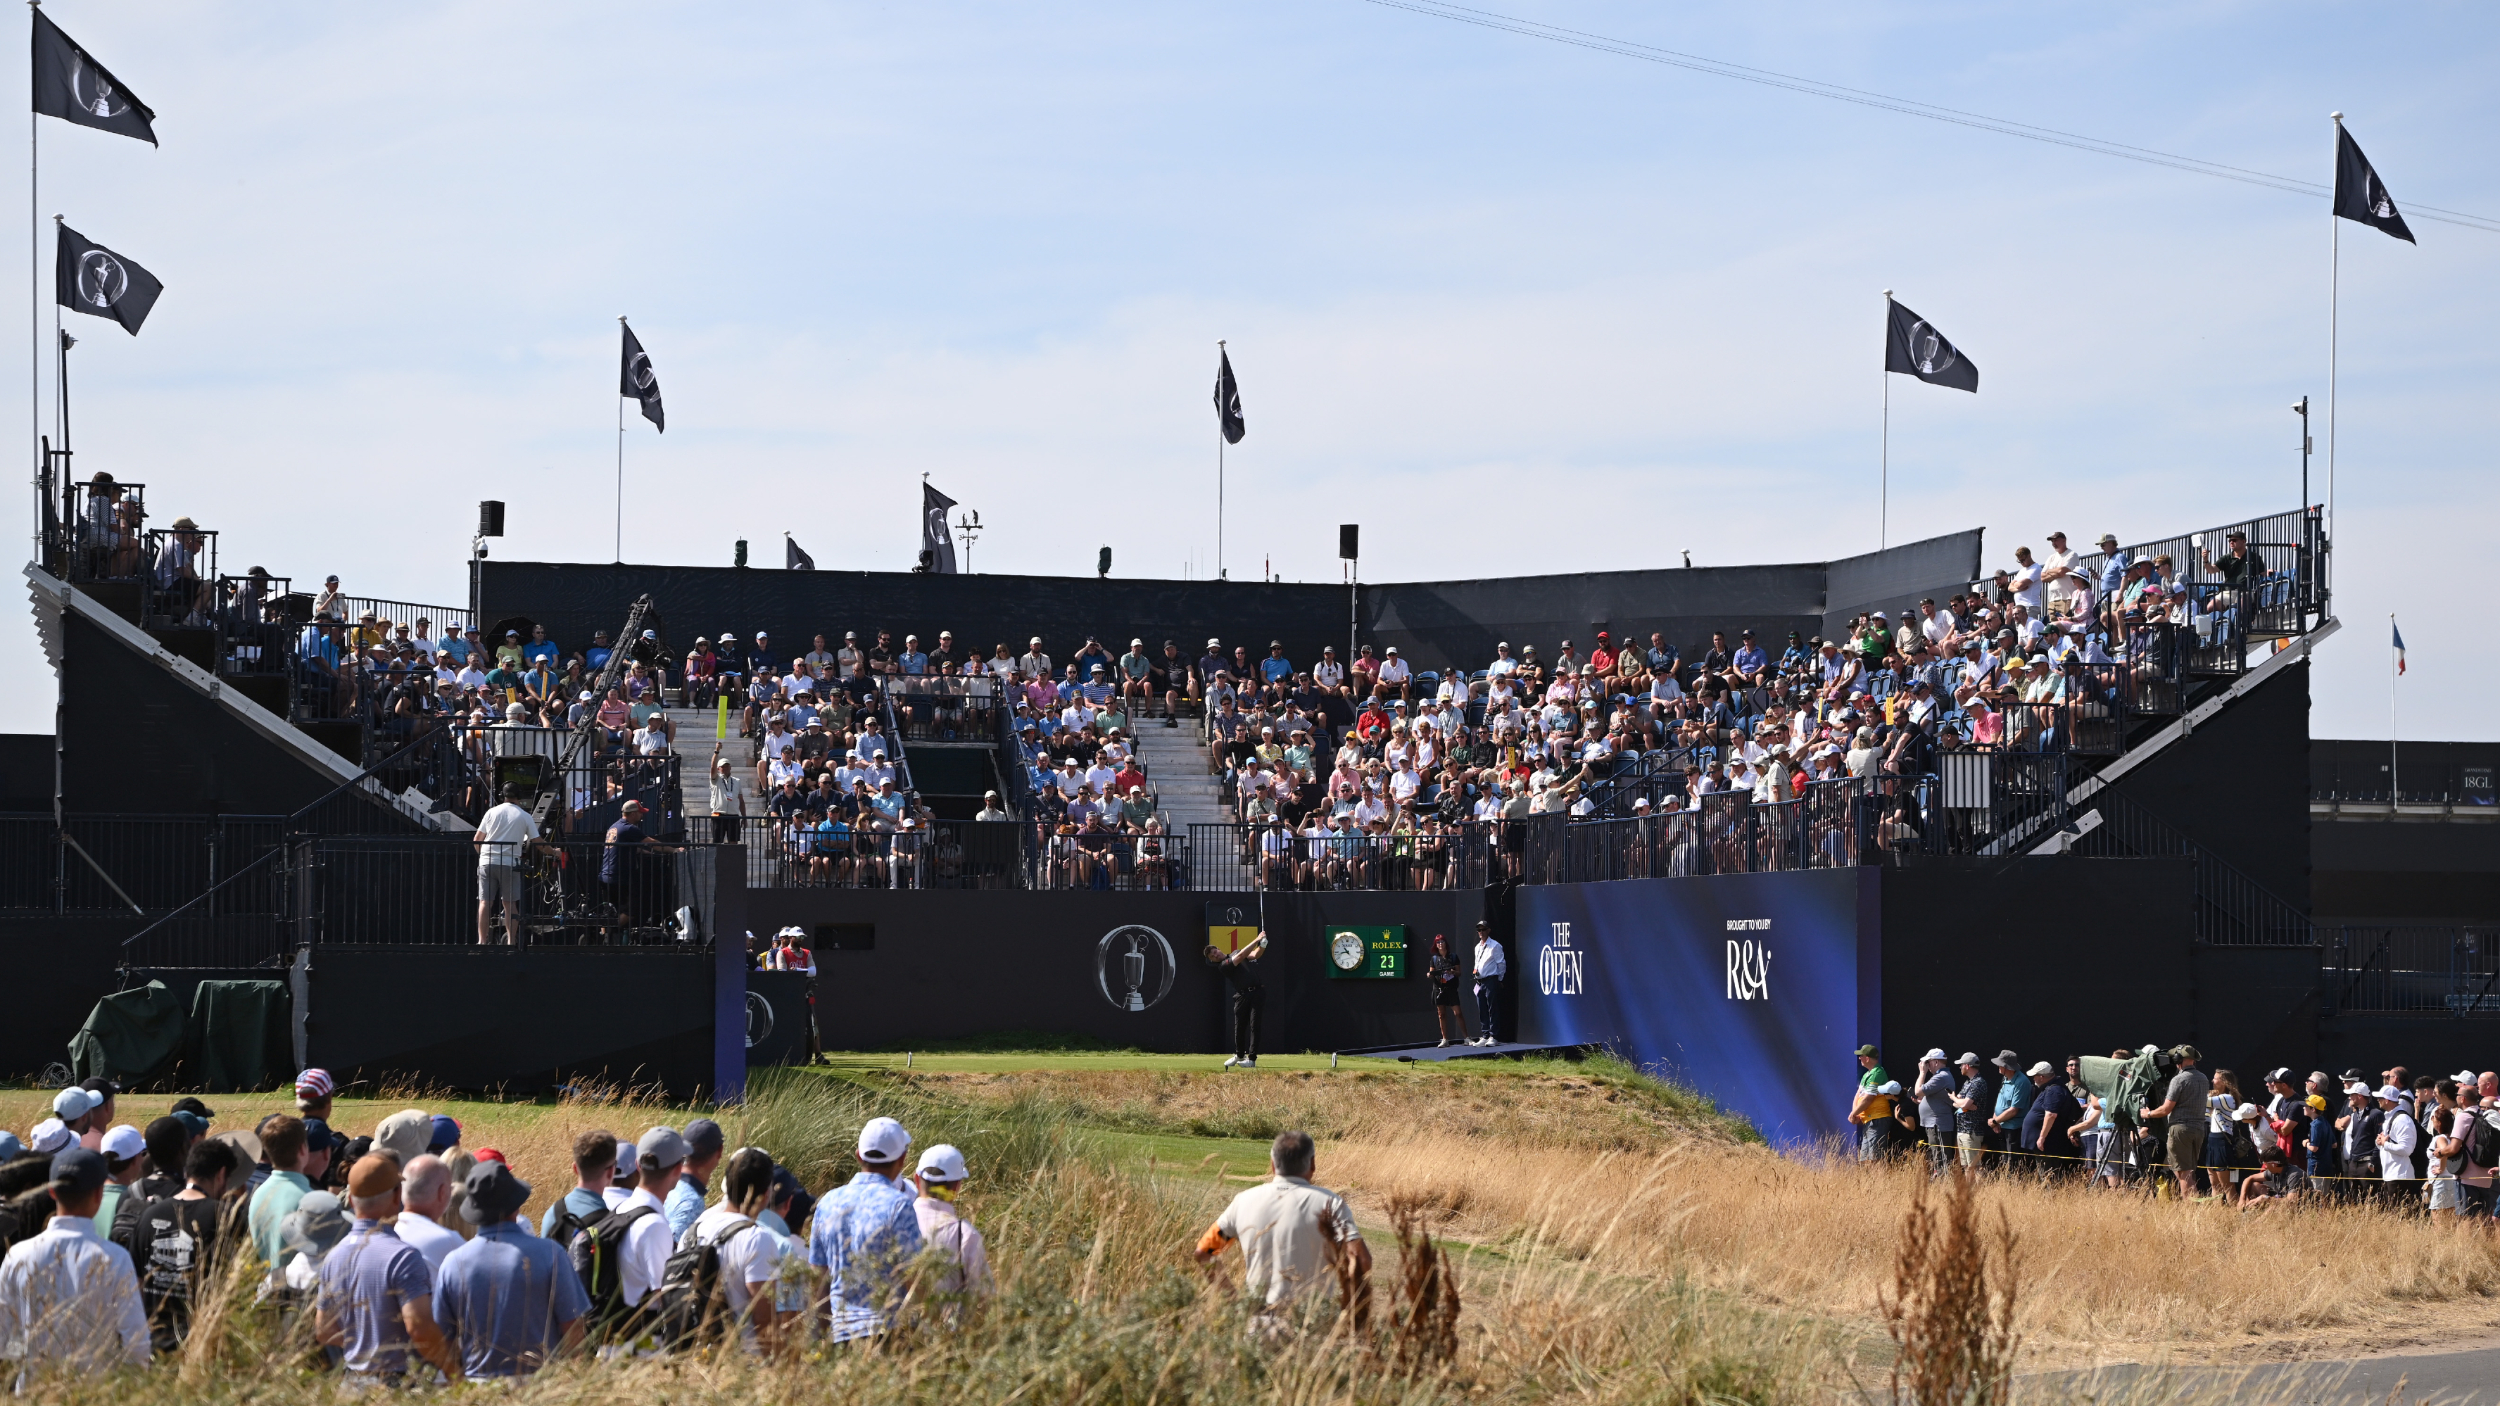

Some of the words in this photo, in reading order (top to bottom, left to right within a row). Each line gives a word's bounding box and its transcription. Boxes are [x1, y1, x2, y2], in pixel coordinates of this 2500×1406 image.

[2465, 776, 2492, 788] 18GL
[1727, 919, 1748, 931] BROUGHT
[1748, 919, 1755, 930] TO
[1755, 919, 1764, 930] YOU
[1765, 919, 1771, 930] BY
[1227, 928, 1238, 953] 1
[1552, 923, 1570, 947] THE
[1381, 955, 1394, 968] 23
[1540, 945, 1583, 995] OPEN
